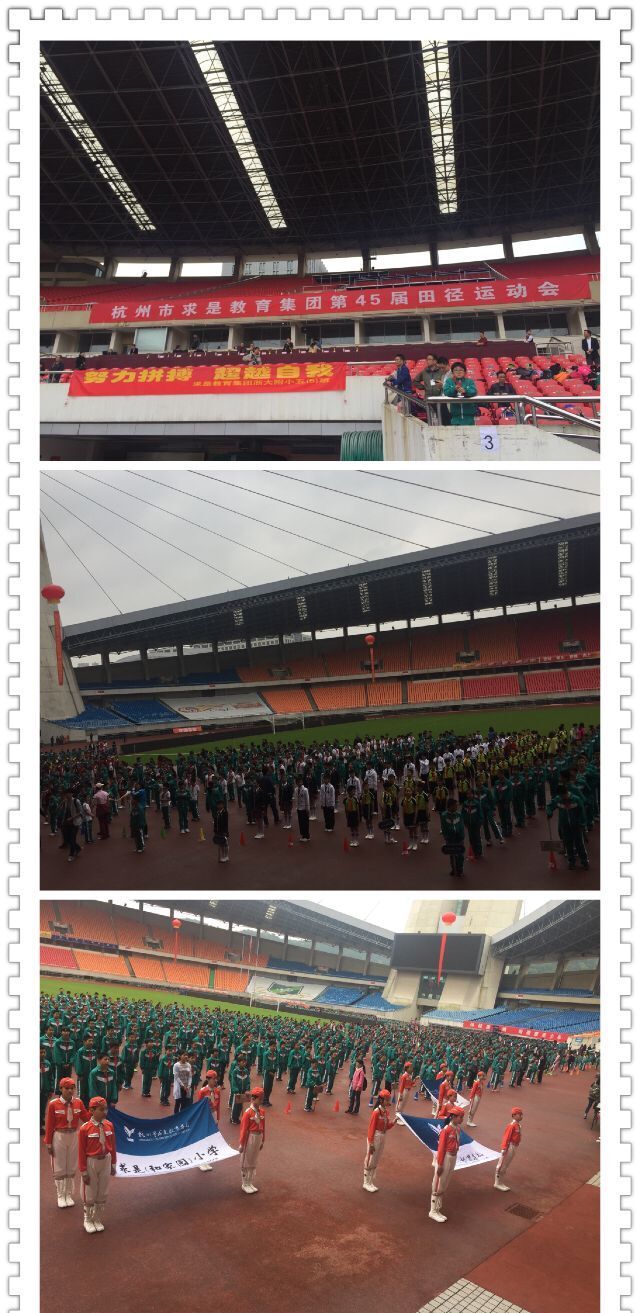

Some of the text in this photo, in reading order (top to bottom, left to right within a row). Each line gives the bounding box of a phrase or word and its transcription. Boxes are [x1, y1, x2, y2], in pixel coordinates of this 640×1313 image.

[111, 281, 559, 319] 杭州市求是教育集团第45届田径运动会
[83, 363, 335, 384] 努力拼搏 超越自我
[484, 434, 494, 450] 3
